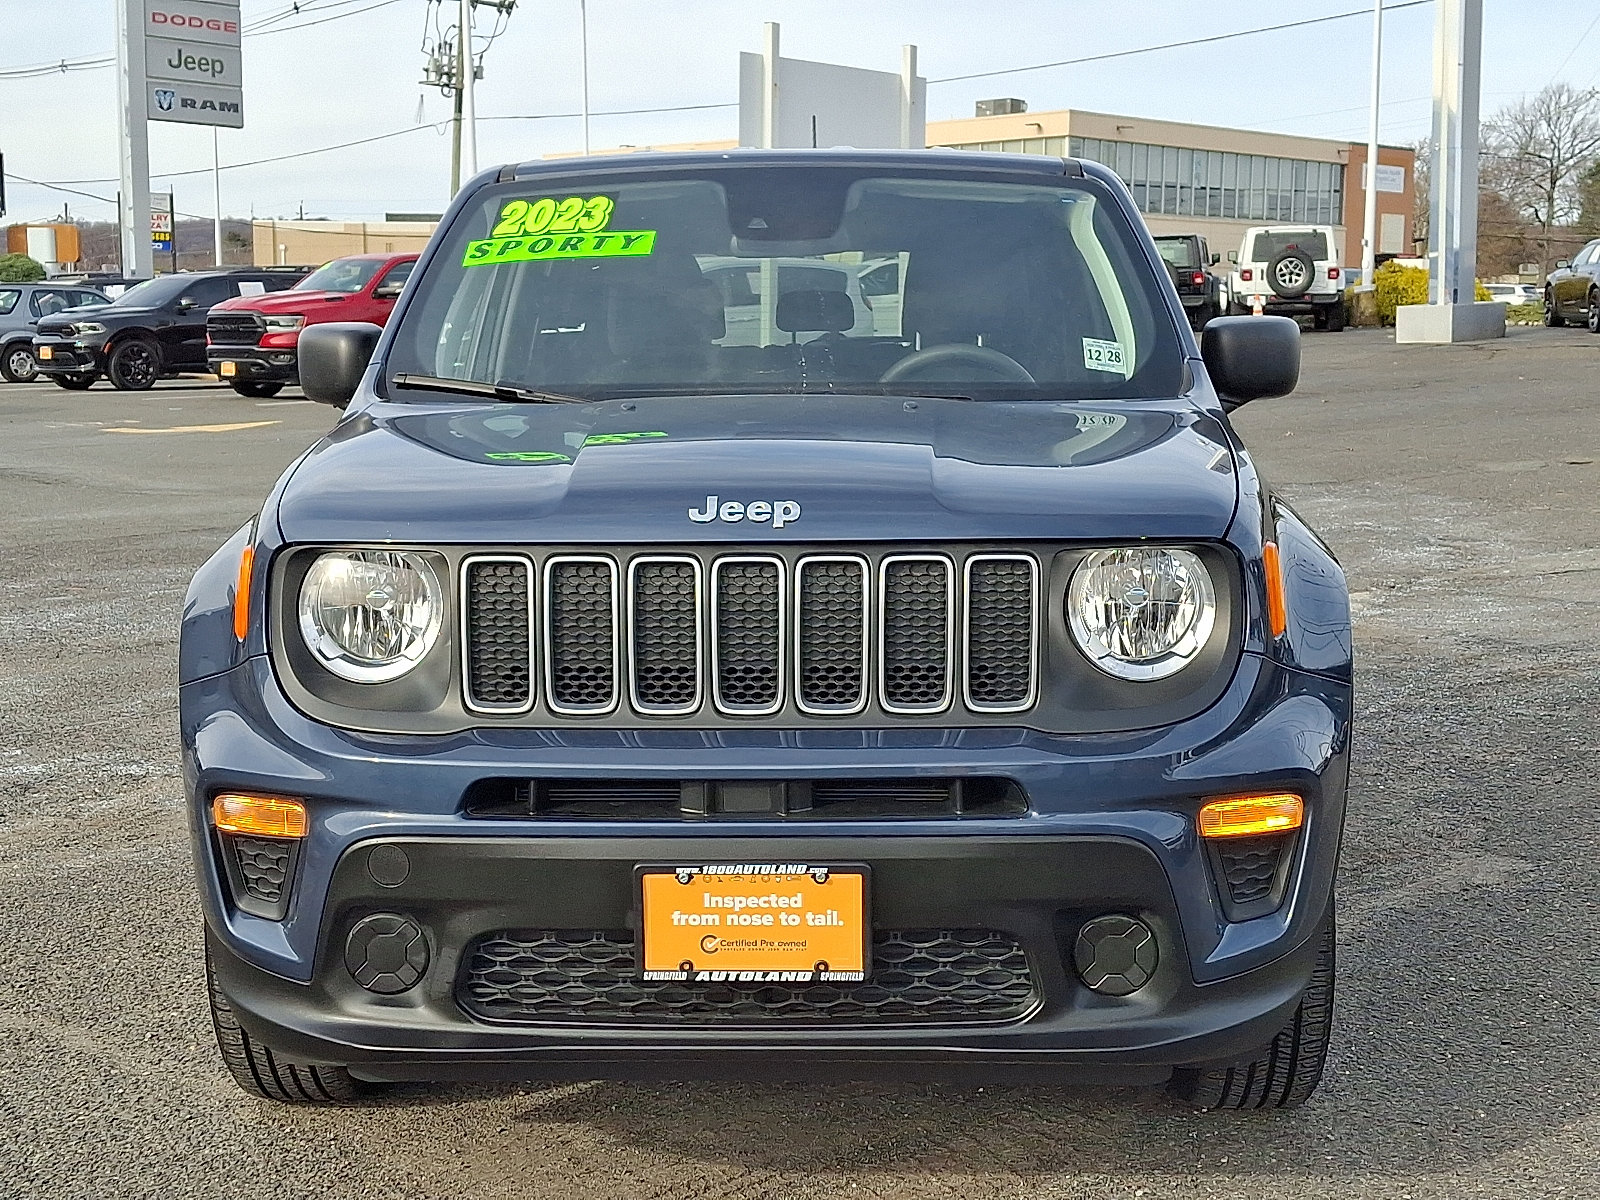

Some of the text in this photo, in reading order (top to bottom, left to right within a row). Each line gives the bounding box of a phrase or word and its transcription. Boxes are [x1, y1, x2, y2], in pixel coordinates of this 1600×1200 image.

[152, 11, 237, 33] DODGE
[167, 48, 224, 78] Jeep
[180, 97, 239, 113] RAM
[492, 195, 614, 238] 2023
[469, 234, 643, 260] SPORTY
[1087, 348, 1121, 364] 12 28
[688, 495, 801, 529] Jeep
[703, 892, 803, 911] Inspected
[671, 909, 845, 927] from nose to tail.
[720, 938, 807, 948] Certified Pre owned
[694, 971, 814, 982] AUTOLAND
